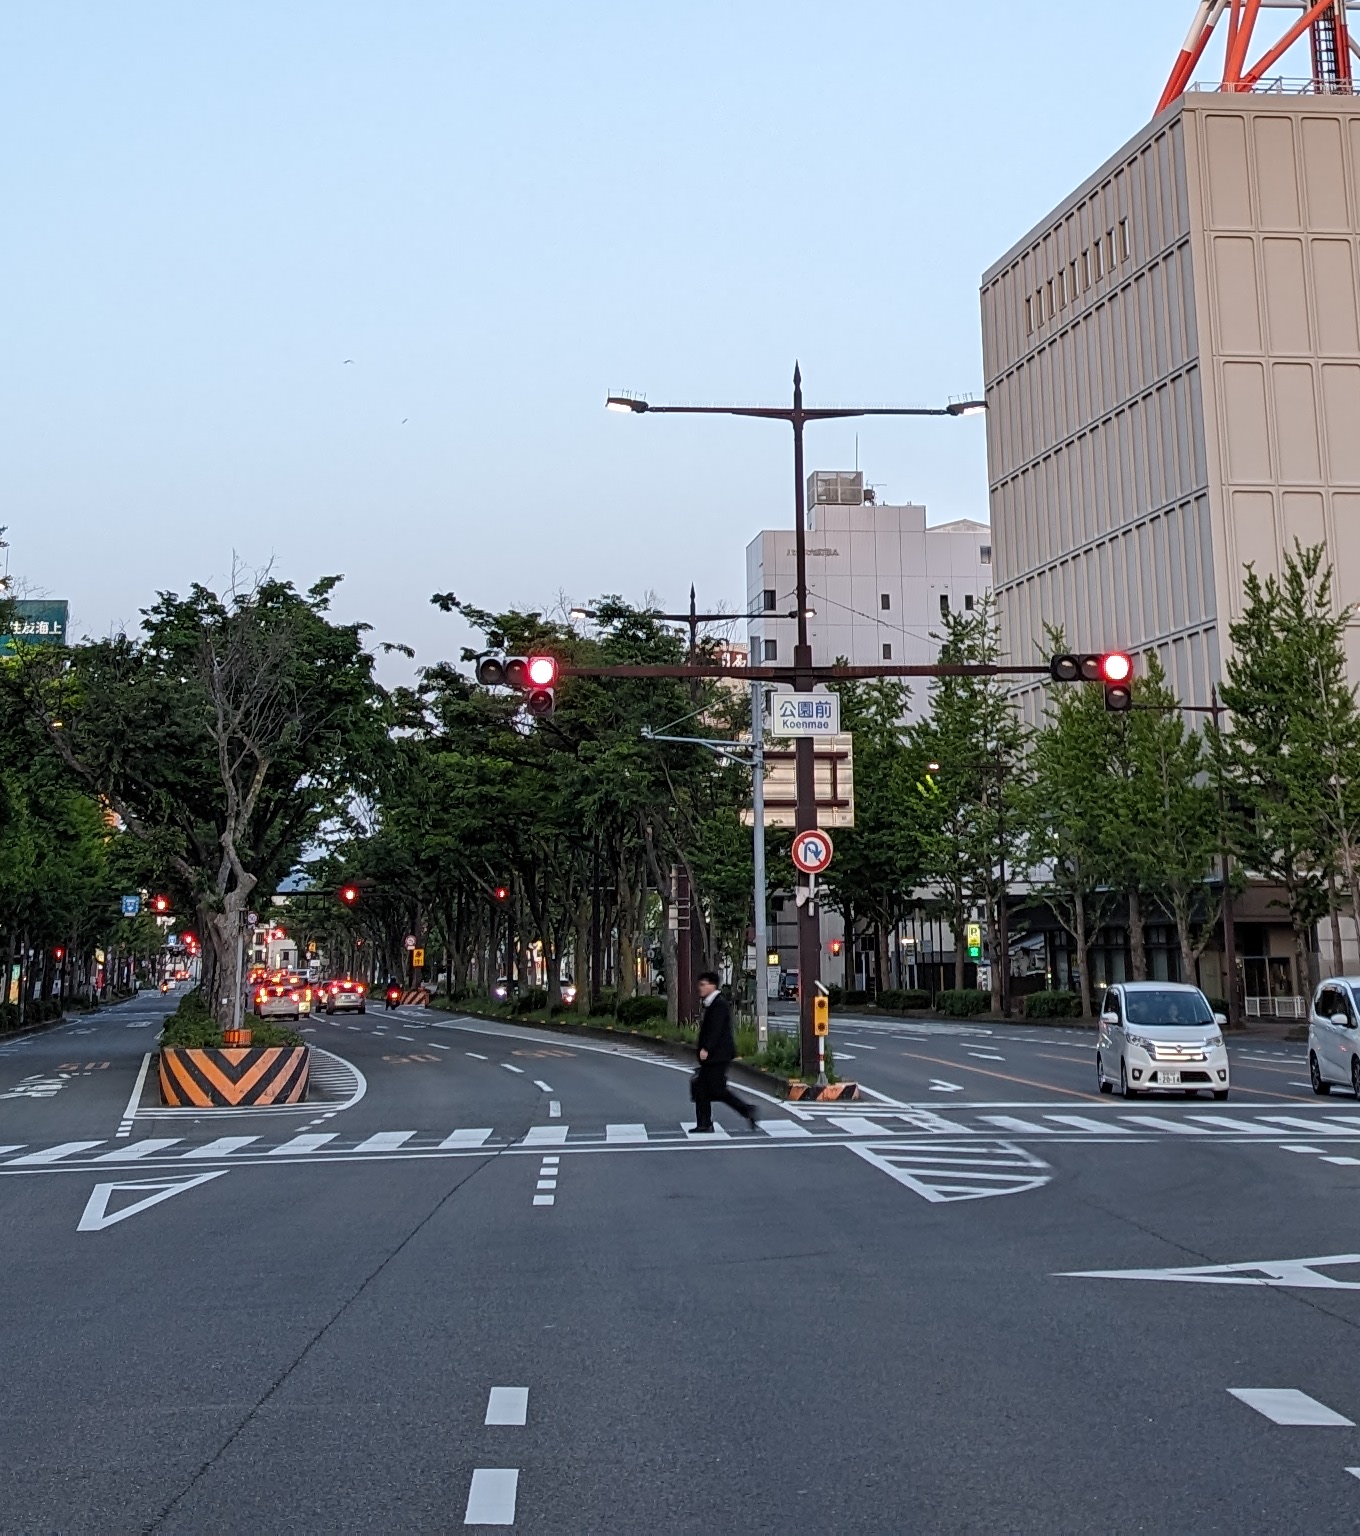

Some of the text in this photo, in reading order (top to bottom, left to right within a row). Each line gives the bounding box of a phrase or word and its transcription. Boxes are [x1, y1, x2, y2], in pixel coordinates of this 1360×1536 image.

[3, 620, 62, 635] 住友海上
[779, 700, 832, 719] 公園前
[782, 719, 829, 729] Koenmae
